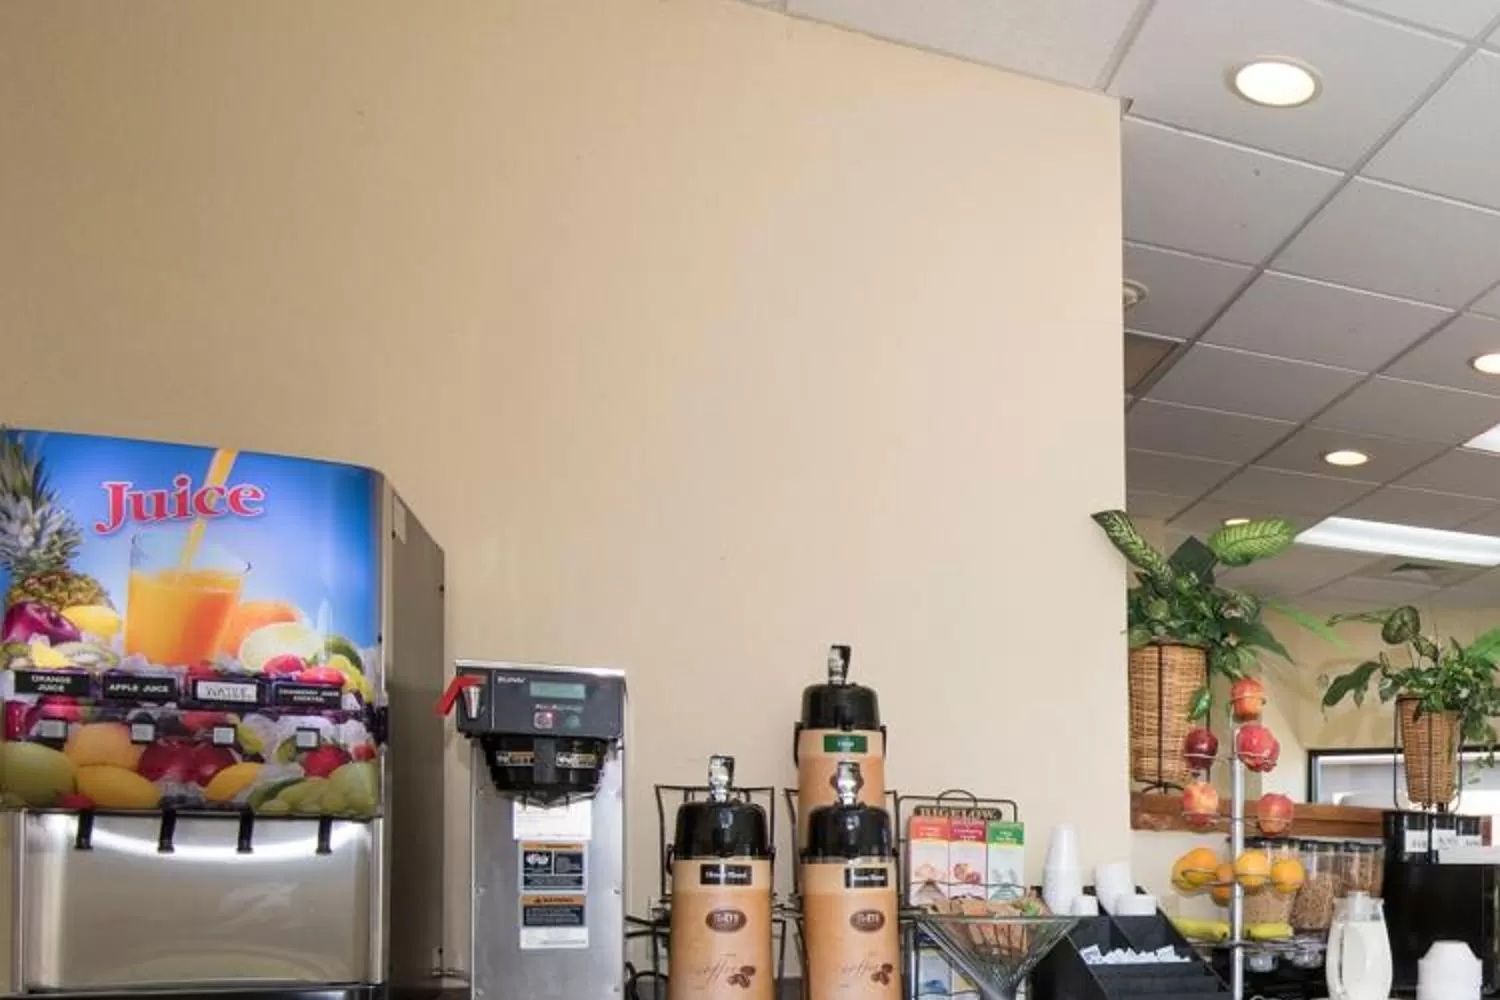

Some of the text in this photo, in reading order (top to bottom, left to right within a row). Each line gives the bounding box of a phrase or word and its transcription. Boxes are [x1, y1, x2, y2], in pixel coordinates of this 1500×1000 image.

[94, 474, 265, 535] Juice
[31, 675, 72, 684] ORANGE
[38, 684, 65, 692] JUICE
[109, 683, 169, 693] APPLE JUICE
